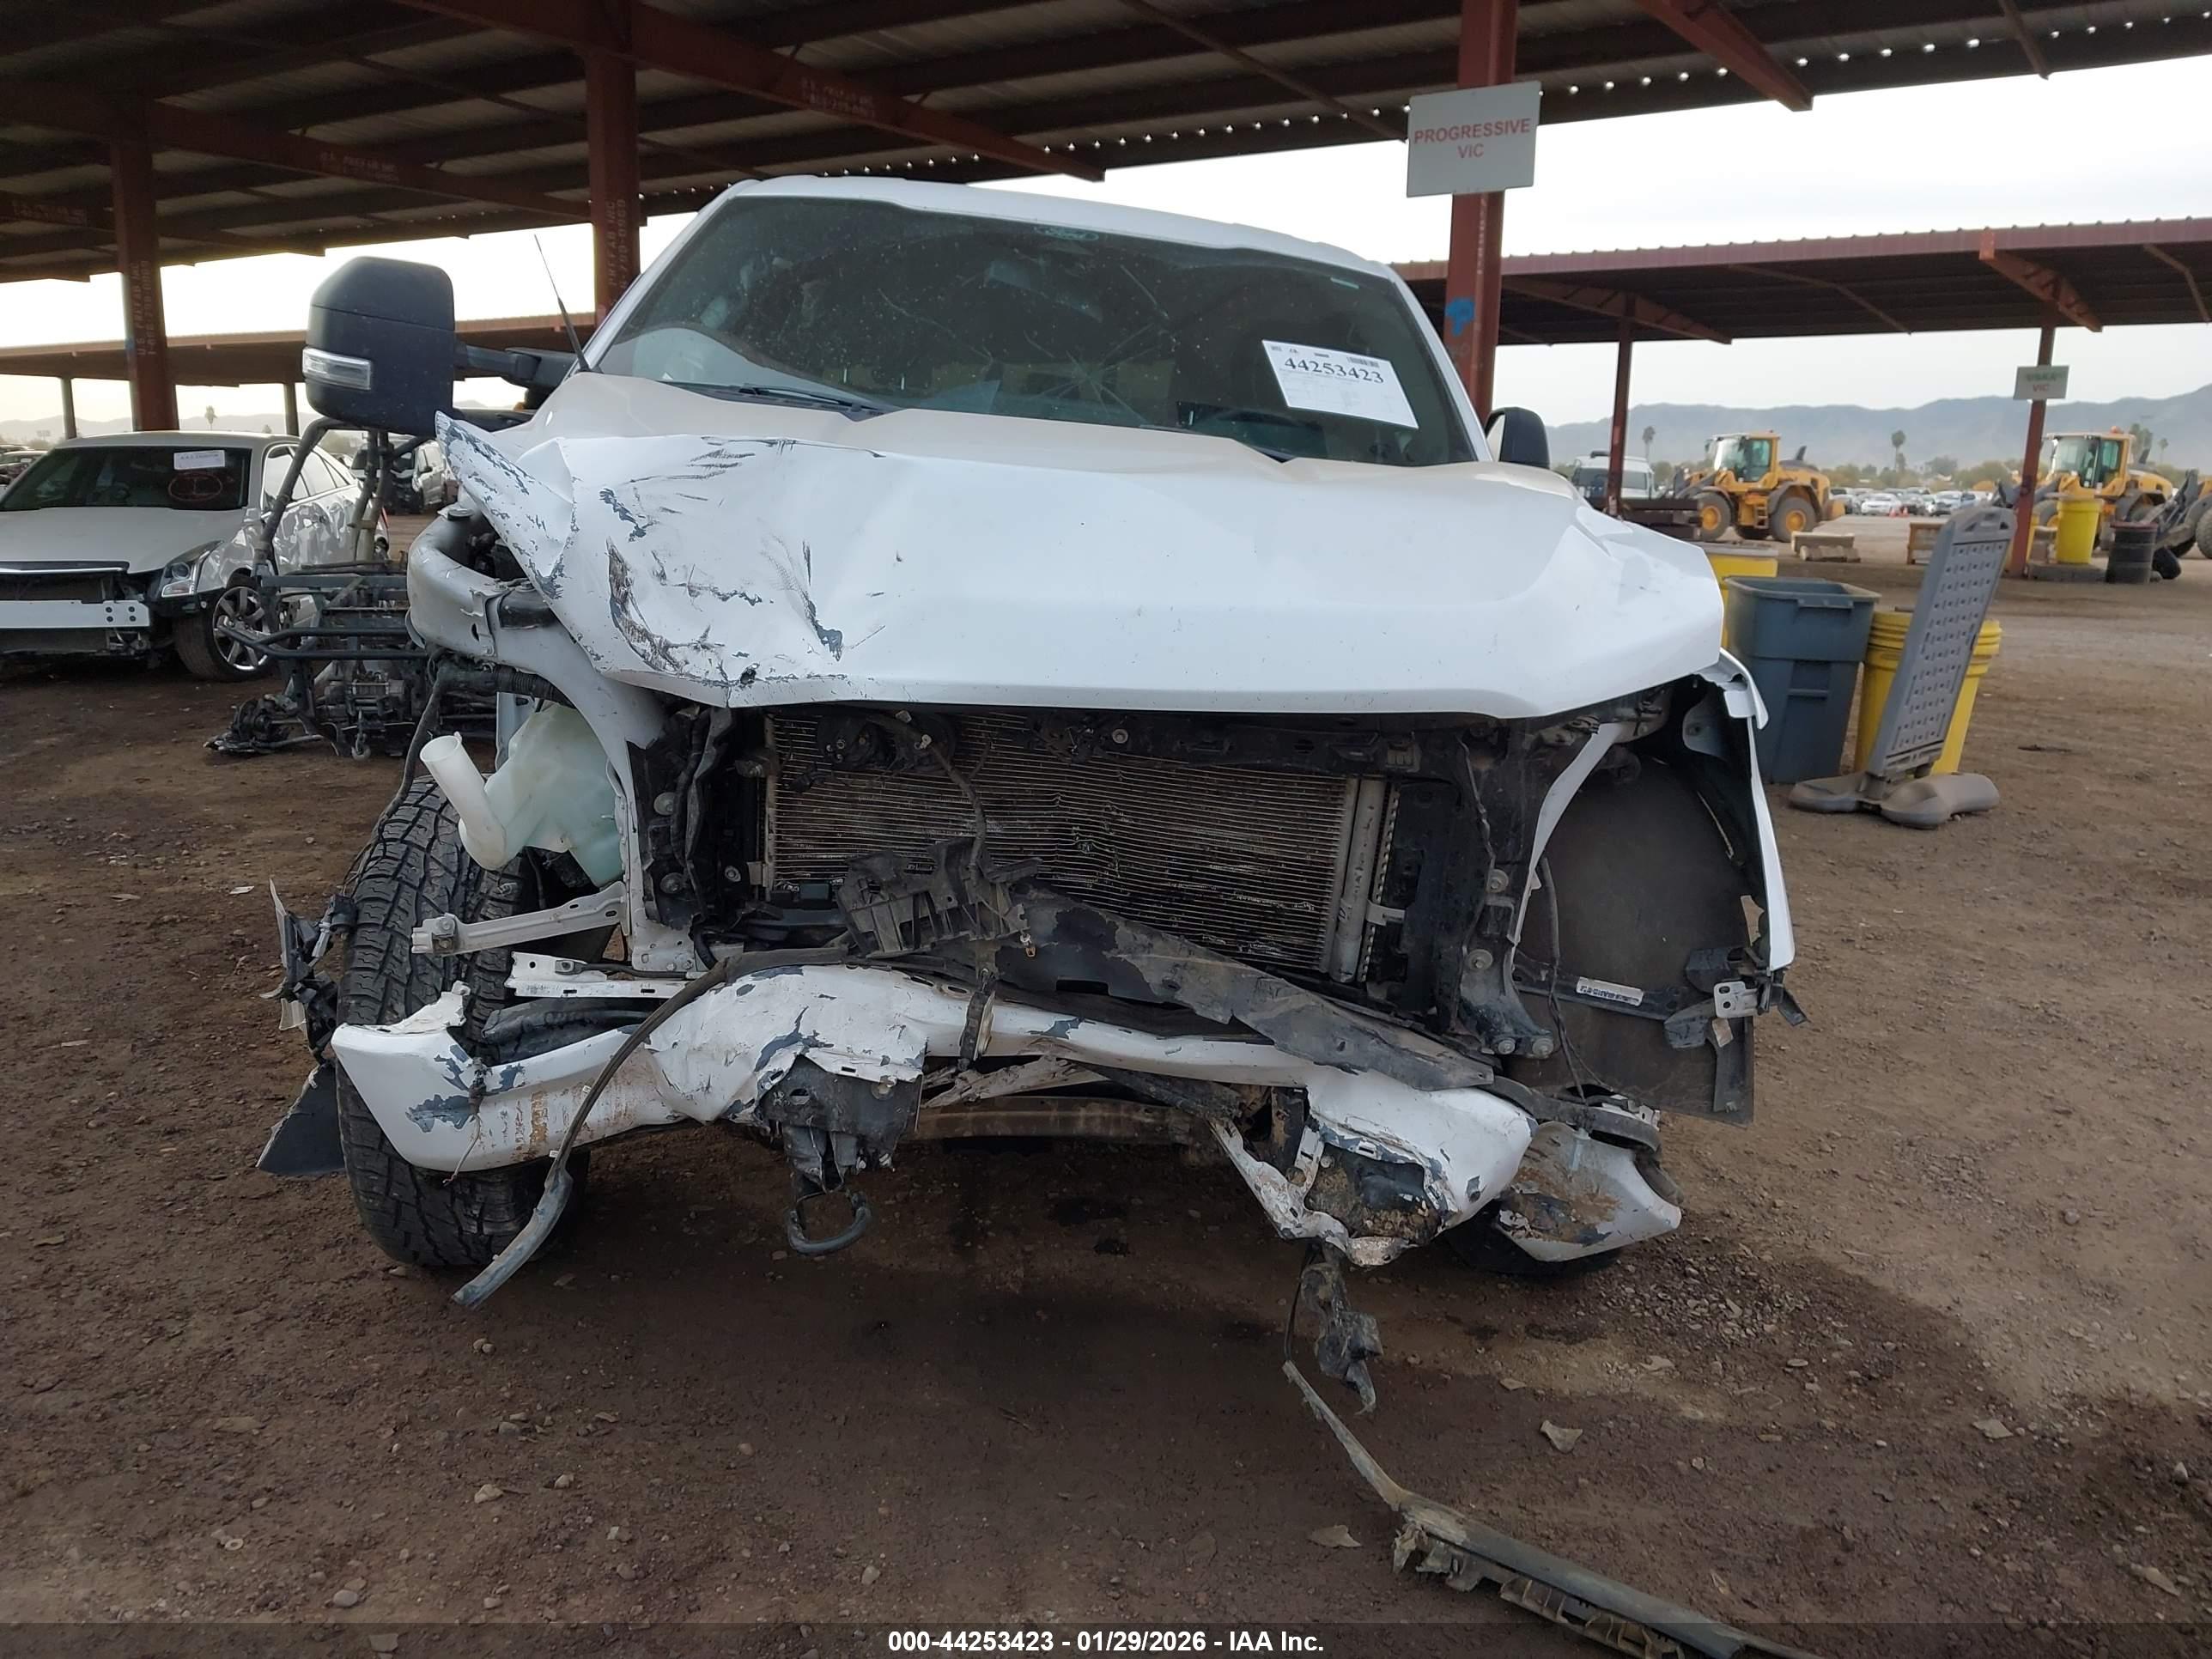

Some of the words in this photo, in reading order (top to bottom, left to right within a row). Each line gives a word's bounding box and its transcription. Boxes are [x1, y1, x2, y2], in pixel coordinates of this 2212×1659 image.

[1413, 118, 1532, 144] PROGRESSIVE
[1457, 143, 1485, 158] VIC
[1284, 357, 1384, 384] 44253423
